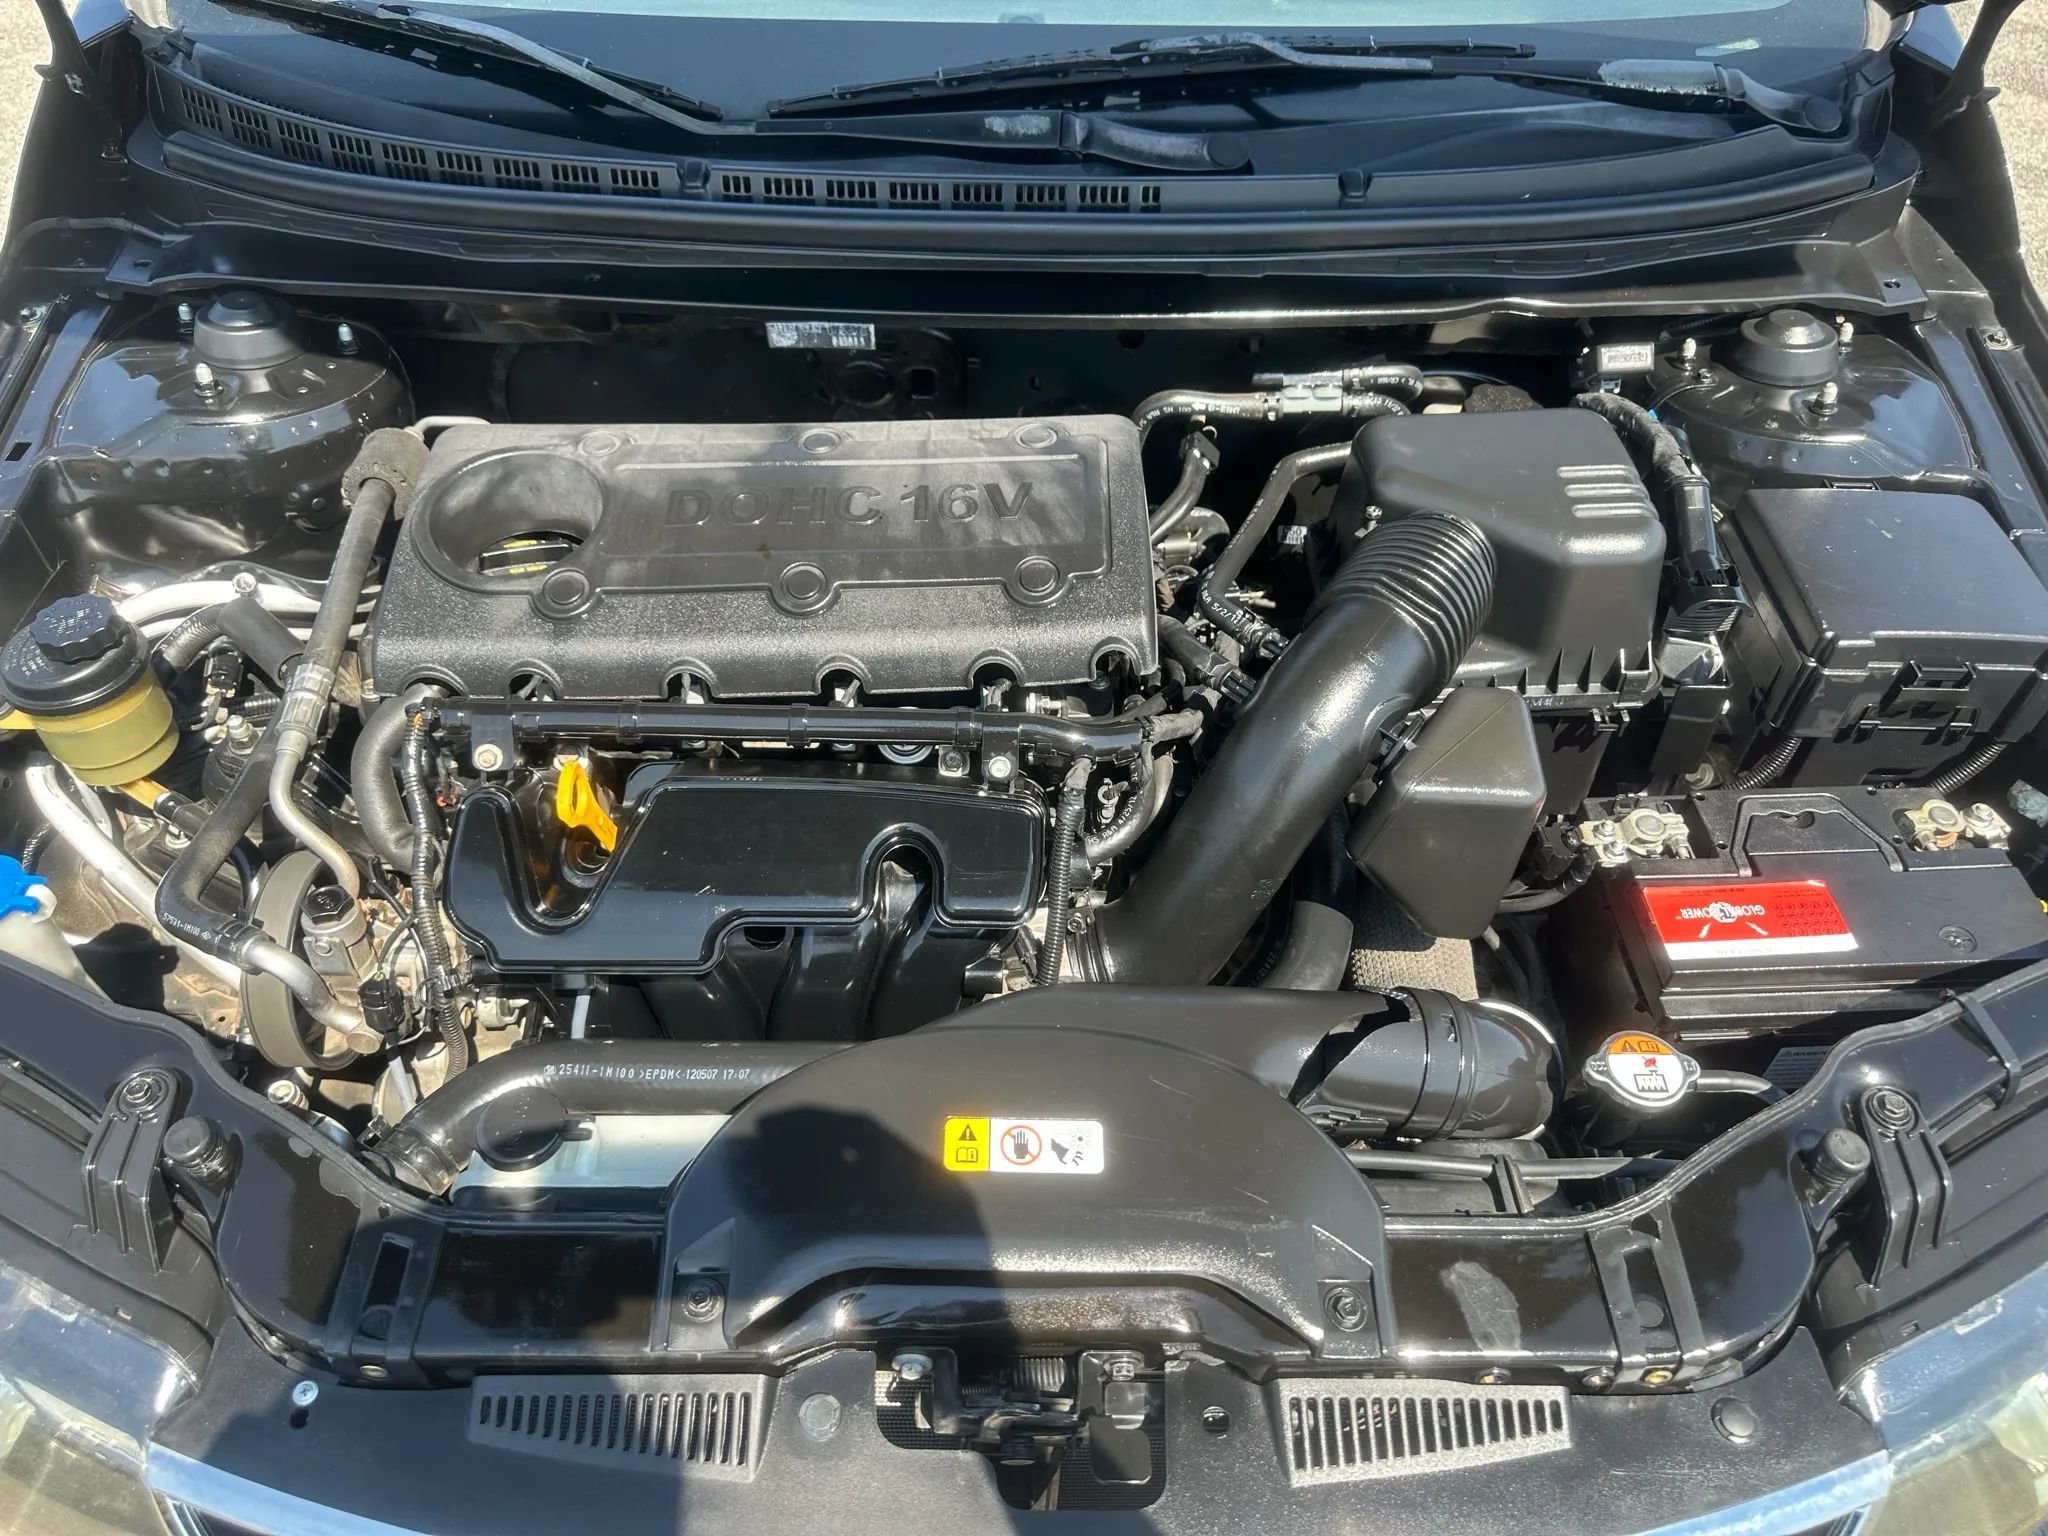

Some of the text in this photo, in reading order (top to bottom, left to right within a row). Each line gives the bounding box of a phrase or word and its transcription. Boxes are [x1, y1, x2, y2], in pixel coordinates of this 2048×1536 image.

[664, 481, 1034, 527] DOHC 16V
[1679, 906, 1719, 919] OWER
[722, 1068, 751, 1080] 17:07
